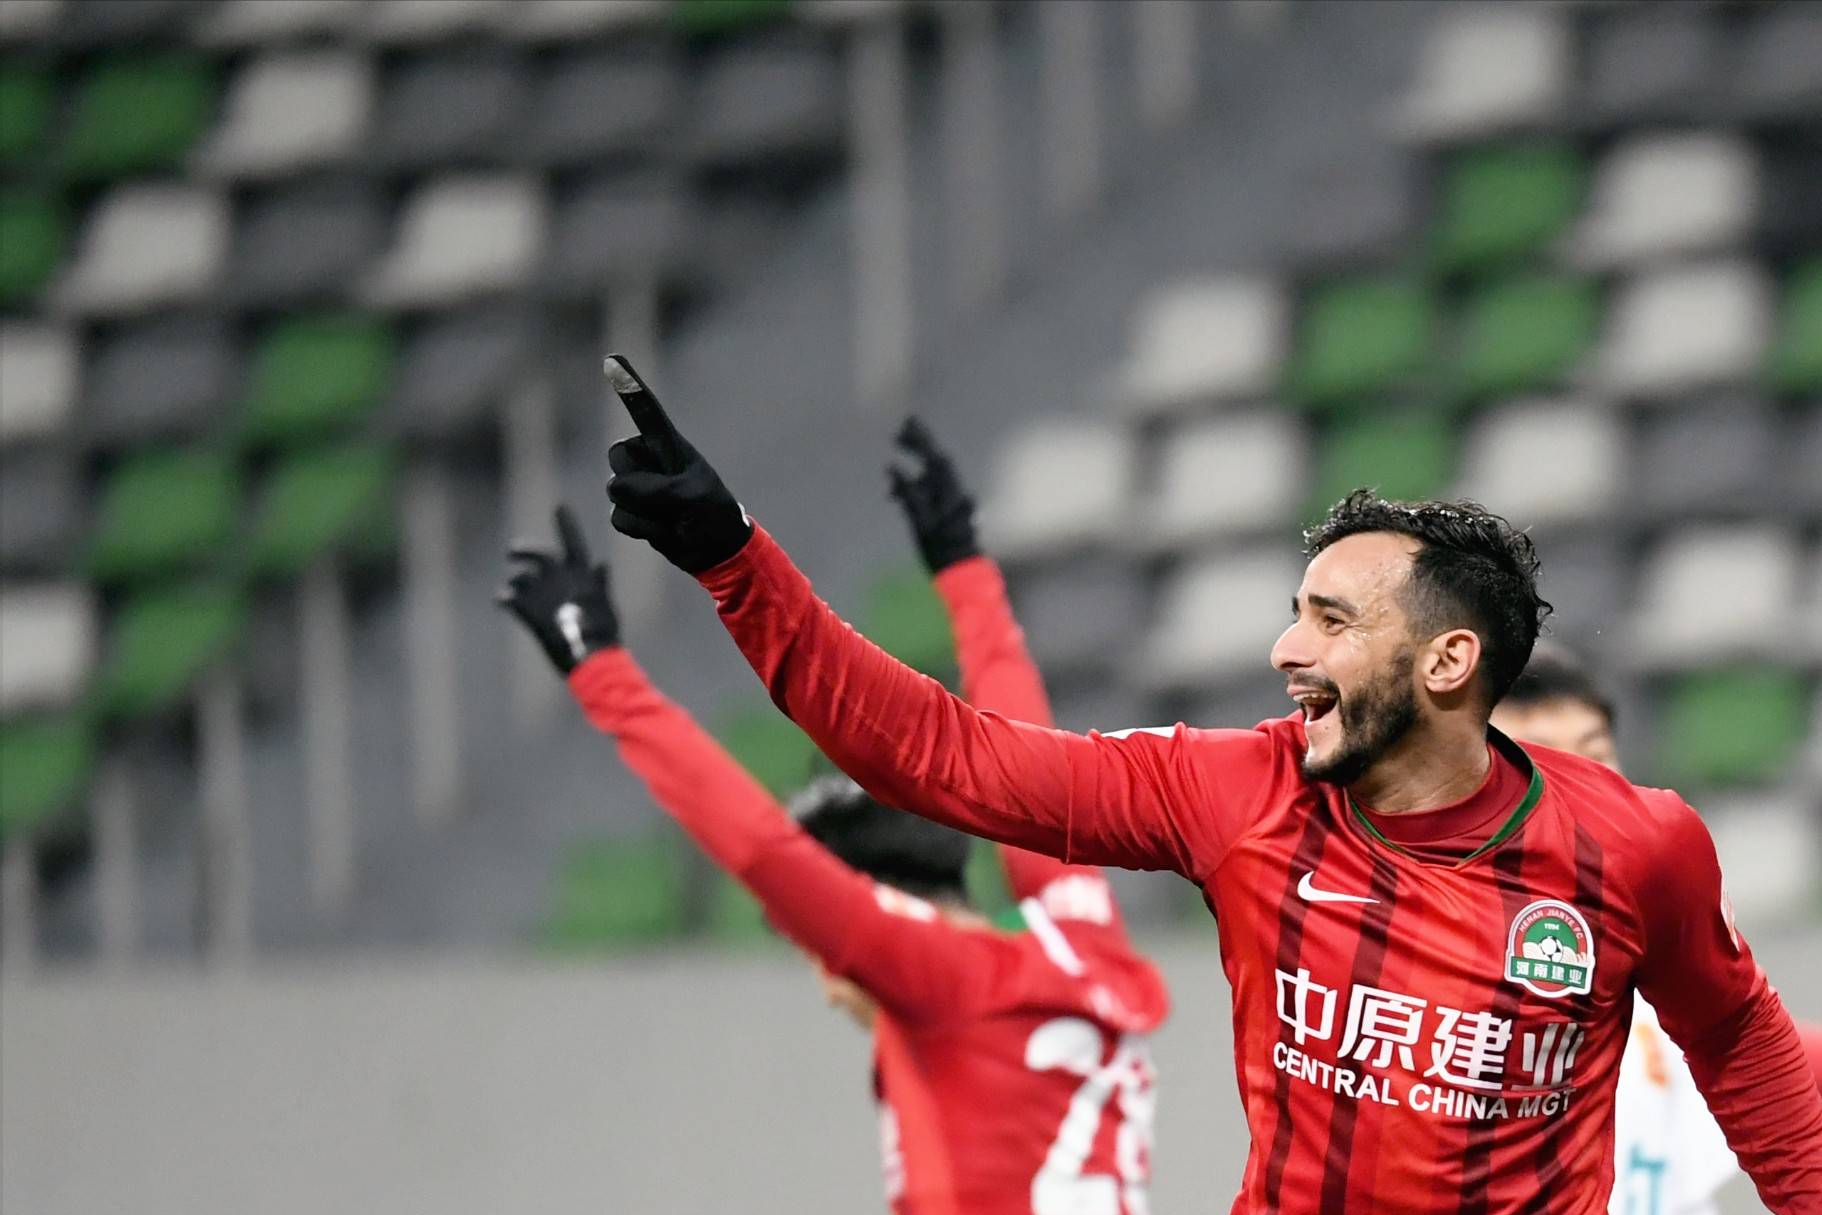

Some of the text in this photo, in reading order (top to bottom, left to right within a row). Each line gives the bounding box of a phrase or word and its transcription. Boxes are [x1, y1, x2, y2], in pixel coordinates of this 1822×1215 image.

[1274, 966, 1586, 1092] 中原建业
[1272, 1041, 1578, 1120] CENTRAL CHINA MGT
